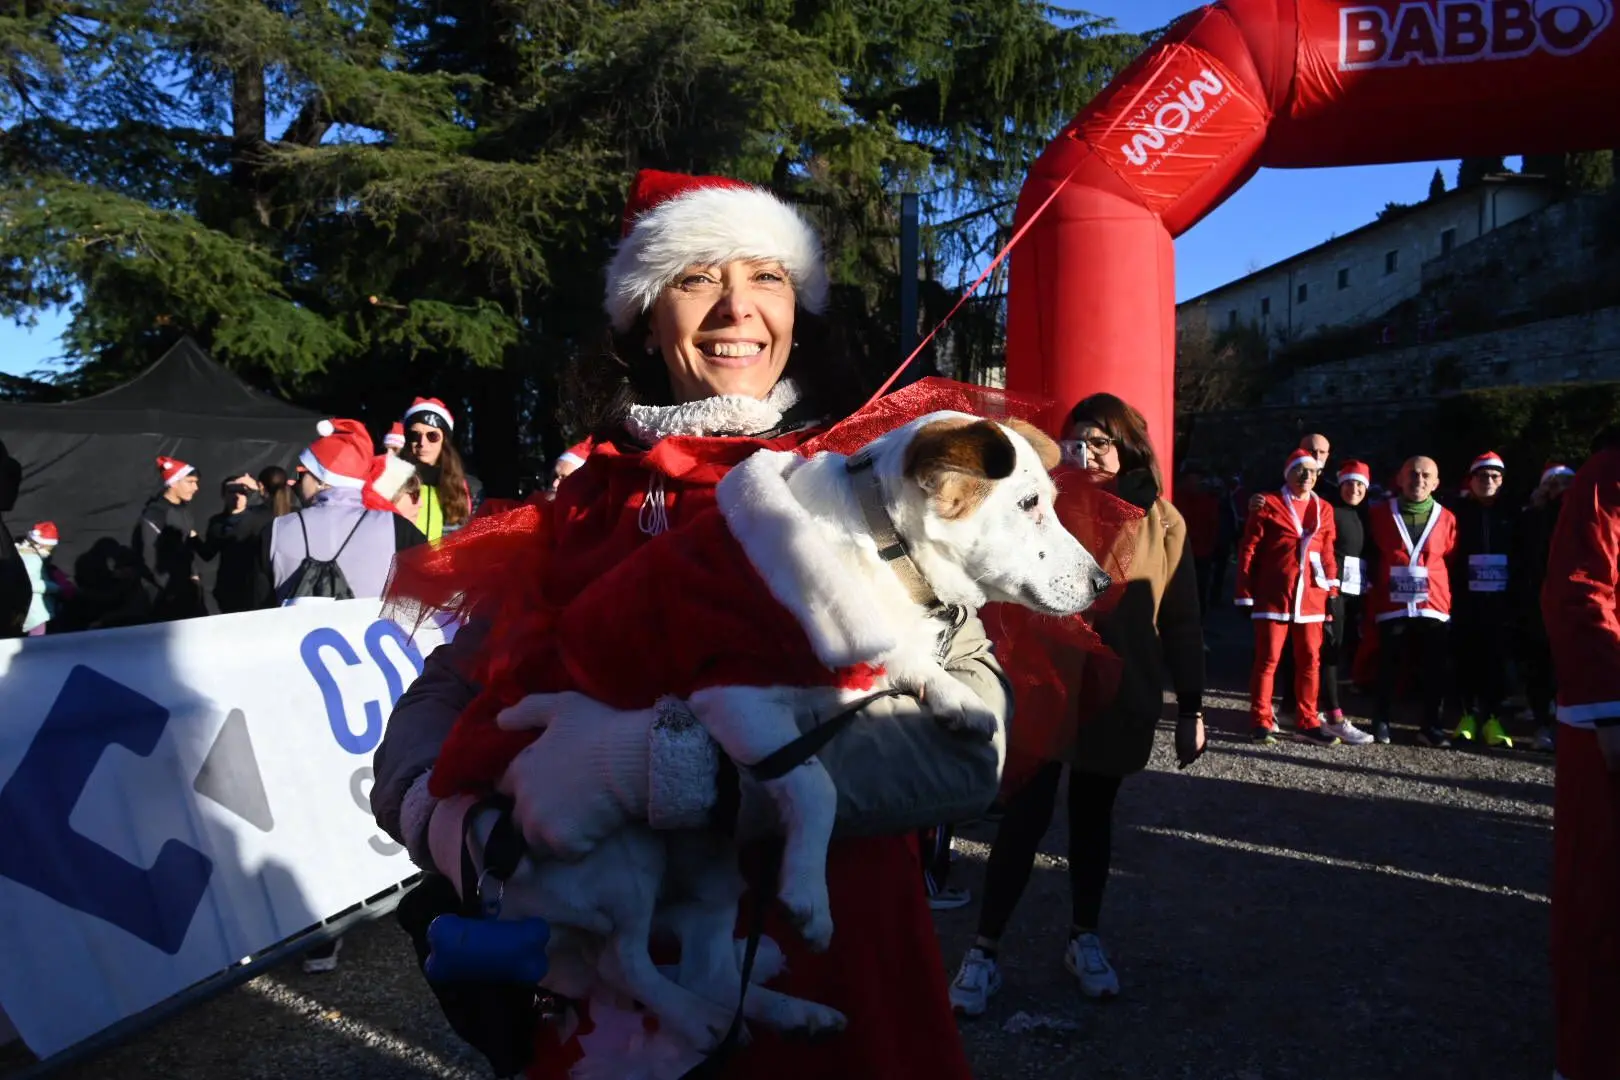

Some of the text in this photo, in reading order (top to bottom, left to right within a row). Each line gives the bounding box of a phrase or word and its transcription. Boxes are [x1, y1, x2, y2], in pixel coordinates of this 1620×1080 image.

[1341, 0, 1602, 67] BABBO
[1121, 69, 1223, 166] WOW
[1125, 75, 1184, 130] EVENTI
[300, 612, 450, 755] CO
